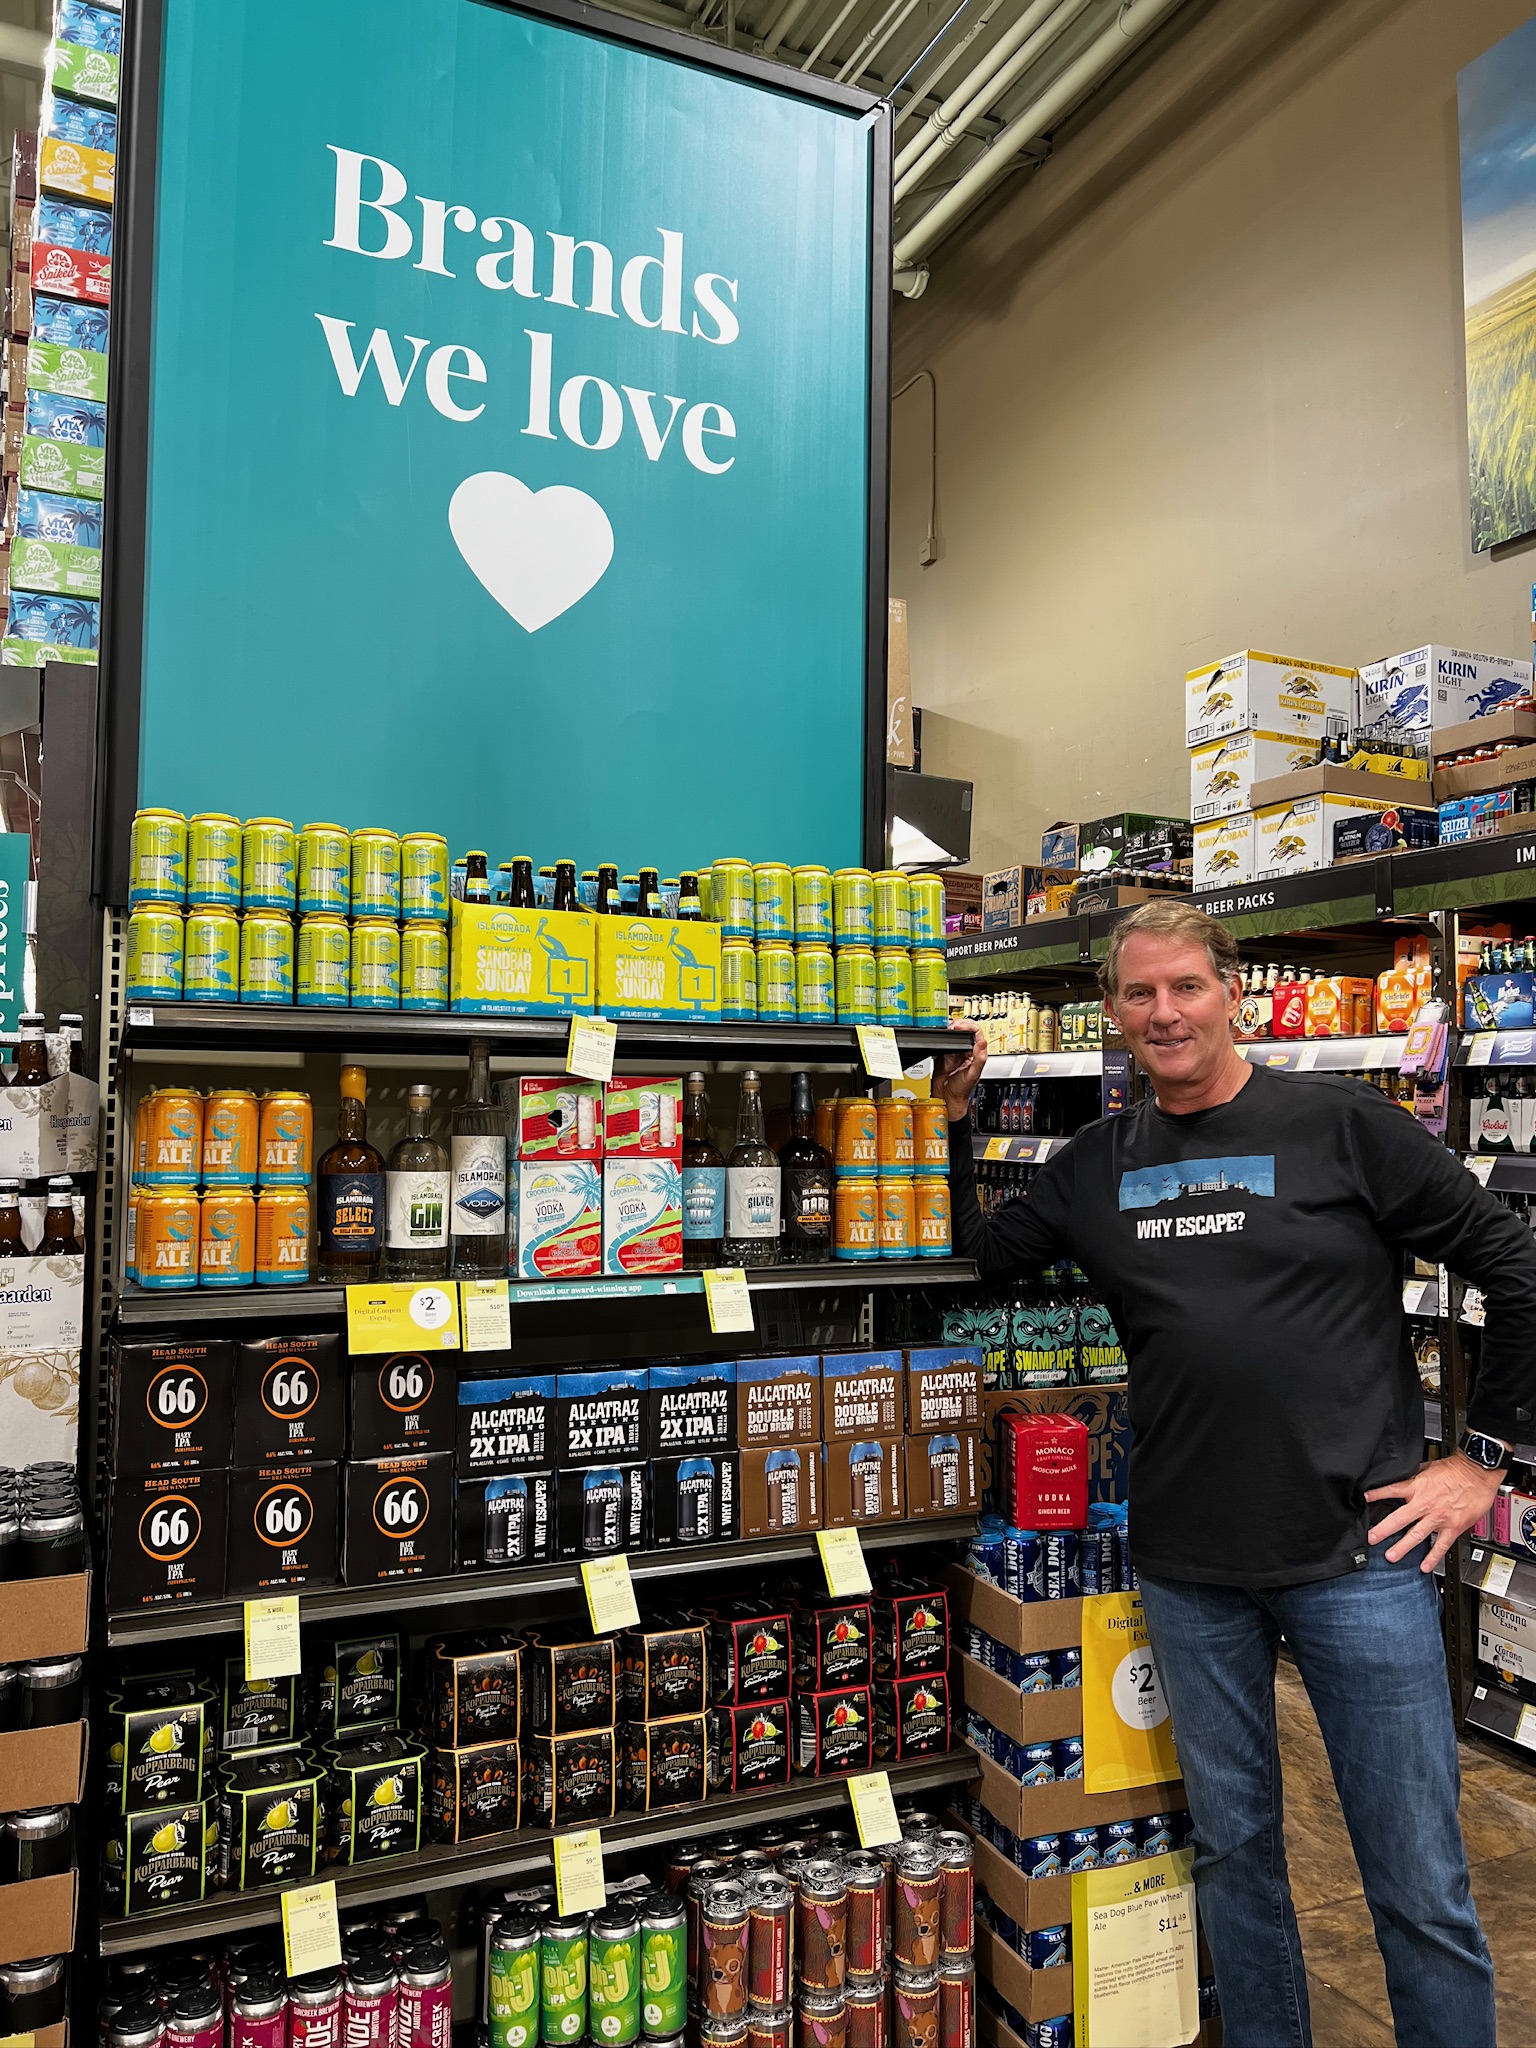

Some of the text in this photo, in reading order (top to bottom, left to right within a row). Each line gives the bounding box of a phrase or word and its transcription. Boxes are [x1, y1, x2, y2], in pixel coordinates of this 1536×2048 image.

[322, 144, 740, 345] Brands
[48, 251, 70, 268] VITA COCO
[39, 264, 77, 281] Spiked
[61, 352, 86, 370] VITA COCO
[314, 312, 737, 475] we love
[55, 417, 83, 439] VITA COCO
[45, 517, 73, 539] VITA COCO
[1438, 659, 1478, 680] KIRIN
[1365, 672, 1405, 697] KIRIN
[1438, 674, 1463, 688] LIGHT
[1365, 691, 1389, 706] LIGHT
[1441, 819, 1469, 833] SELTZER
[1042, 851, 1076, 866] LANDSHARK
[1205, 891, 1275, 916] BEER PACKS
[477, 921, 531, 934] ISLAMORADA
[615, 931, 665, 944] ISLAMORADA
[946, 936, 1018, 958] IMPORT BEER PACKS
[476, 951, 532, 973] SANDBAR
[615, 960, 666, 981] SANDBAR
[476, 968, 531, 994] SUNDAY
[562, 968, 571, 985] 1
[693, 975, 700, 991] 1
[615, 976, 665, 1000] SUNDAY
[1481, 1119, 1508, 1131] Grolsch
[157, 1147, 192, 1164] ALE
[203, 1147, 232, 1165] ALE
[265, 1149, 298, 1165] ALE
[853, 1147, 876, 1160] ALE
[925, 1145, 948, 1159] ALE
[458, 1171, 504, 1183] ISLAMORADA
[336, 1195, 374, 1205] ISLAMORADA
[411, 1192, 443, 1201] ISLAMORADA
[464, 1199, 501, 1208] VODKA
[747, 1196, 774, 1209] SILVER
[534, 1201, 565, 1217] VODKA
[618, 1201, 647, 1216] VODKA
[802, 1197, 830, 1214] DARK
[336, 1207, 374, 1226] SELECT
[410, 1203, 443, 1229] GIN
[922, 1226, 948, 1239] ALE
[1137, 1211, 1246, 1240] WHY ESCAPE?
[850, 1229, 875, 1242] ALE
[156, 1250, 190, 1267] ALE
[201, 1249, 232, 1265] ALE
[277, 1247, 307, 1262] ALE
[516, 1288, 556, 1298] Download
[571, 1284, 625, 1297] award-winning
[625, 1286, 642, 1297] app
[354, 1307, 376, 1316] Digital
[419, 1296, 436, 1311] $2
[152, 1347, 207, 1357] HEAD SOUTH
[1015, 1347, 1075, 1372] SWAMP APE
[272, 1370, 309, 1407] 66
[388, 1364, 424, 1400] 66
[834, 1376, 895, 1398] ALCATRAZ
[920, 1371, 977, 1391] ALCATRAZ
[158, 1377, 196, 1415] 66
[660, 1389, 728, 1412] ALCATRAZ
[748, 1382, 812, 1404] ALCATRAZ
[568, 1398, 639, 1422] ALCATRAZ
[834, 1401, 879, 1418] DOUBLE
[920, 1396, 962, 1412] DOUBLE
[470, 1405, 545, 1430] ALCATRAZ
[747, 1407, 794, 1425] DOUBLE
[834, 1414, 879, 1428] COLD BREW
[920, 1407, 962, 1421] COLD BREW
[404, 1421, 420, 1430] IPA
[470, 1423, 545, 1436] BREWING
[660, 1415, 715, 1440] 2X IPA
[747, 1420, 794, 1434] COLD BREW
[174, 1438, 191, 1448] IPA
[175, 1431, 192, 1440] HAZY
[568, 1423, 626, 1450] 2X IPA
[469, 1433, 530, 1459] 2X IPA
[1035, 1447, 1075, 1457] MONACO
[377, 1459, 428, 1470] HEAD SOUTH
[1031, 1463, 1078, 1475] MOSCOW MULE
[487, 1498, 525, 1511] ALCATRAZ
[629, 1470, 642, 1536] WHY ESCAPE?
[782, 1481, 792, 1526] DOUBLE
[1037, 1492, 1071, 1502] VODKA
[265, 1497, 302, 1534] 66
[383, 1488, 419, 1526] 66
[534, 1479, 547, 1547] WHY ESCAPE?
[150, 1507, 189, 1547] 66
[507, 1512, 521, 1557] 2X IPA
[1047, 1536, 1060, 1600] SEA DOG
[1107, 1614, 1143, 1631] Digital
[1491, 1603, 1528, 1628] Corona
[1500, 1618, 1518, 1632] Extra
[902, 1635, 945, 1652] KOPPARBERG
[1494, 1643, 1523, 1663] Corona
[1129, 1663, 1155, 1693] $2
[341, 1679, 395, 1701] KOPPARBERG
[231, 1698, 288, 1719] KOPPARBERG
[352, 1694, 383, 1709] Pear
[1137, 1695, 1157, 1706] Beer
[243, 1712, 275, 1729] Pear
[822, 1731, 868, 1750] KOPPARBERG
[131, 1757, 196, 1782] KOPPARBERG
[144, 1774, 181, 1792] Pear
[249, 1834, 310, 1859] KOPPARBERG
[262, 1851, 296, 1868] Pear
[1142, 1873, 1166, 1891] MORE
[1093, 1891, 1183, 1920] Sea Dog Blue Paw Wheat
[1093, 1922, 1107, 1931] Ale
[357, 1999, 381, 2009] BREWERY
